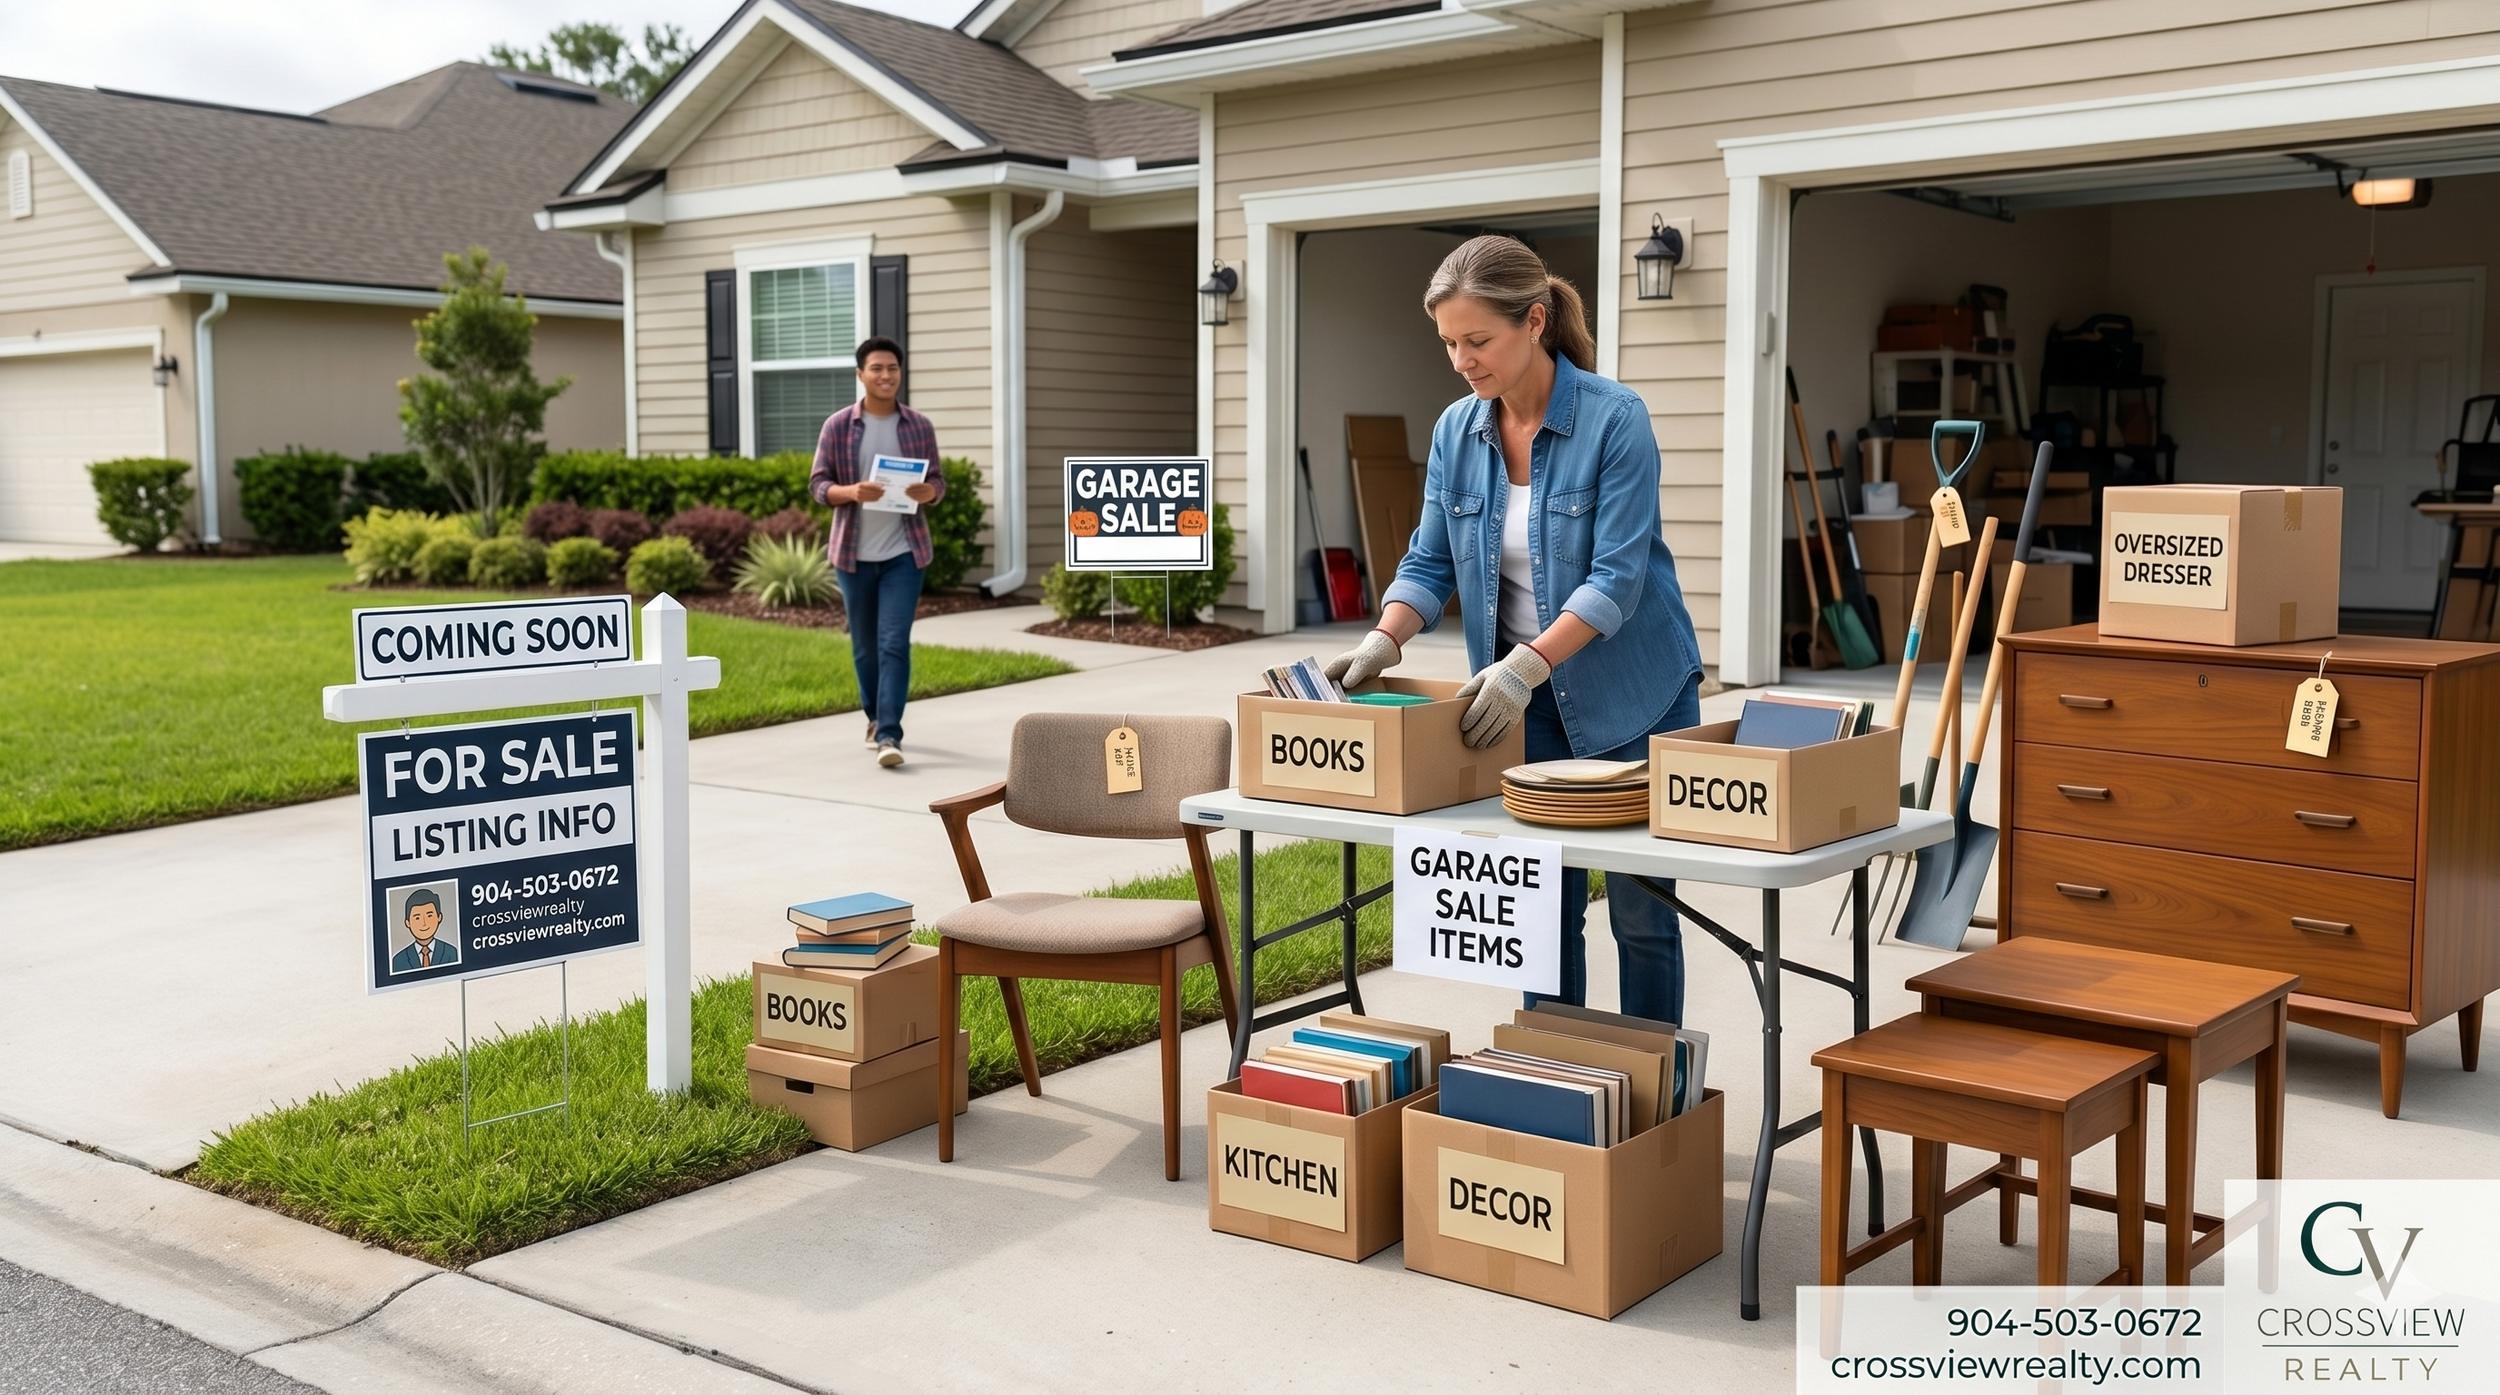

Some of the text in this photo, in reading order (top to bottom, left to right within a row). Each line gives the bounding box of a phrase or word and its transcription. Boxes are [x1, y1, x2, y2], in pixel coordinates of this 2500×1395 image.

[1076, 468, 1200, 499] GARAGE
[1101, 503, 1176, 533] SALE
[2115, 533, 2223, 558] OVERSIZED
[2124, 562, 2212, 587] DRESSER
[372, 614, 619, 664] COMING SOON
[385, 730, 619, 798] FOR SALE
[1271, 734, 1365, 773] BOOKS
[1669, 774, 1768, 816] DECOR
[392, 802, 616, 862] LISTING INFO
[471, 864, 619, 907] 904-503-0672
[1411, 846, 1541, 889] GARAGE
[472, 898, 585, 928] crossviewrealty
[1435, 888, 1515, 927] SALE
[472, 912, 626, 950] crossviewrealty.com
[1430, 927, 1524, 968] ITEMS
[767, 992, 847, 1031] BOOKS
[1225, 1144, 1338, 1198] KITCHEN
[1450, 1177, 1552, 1232] DECOR
